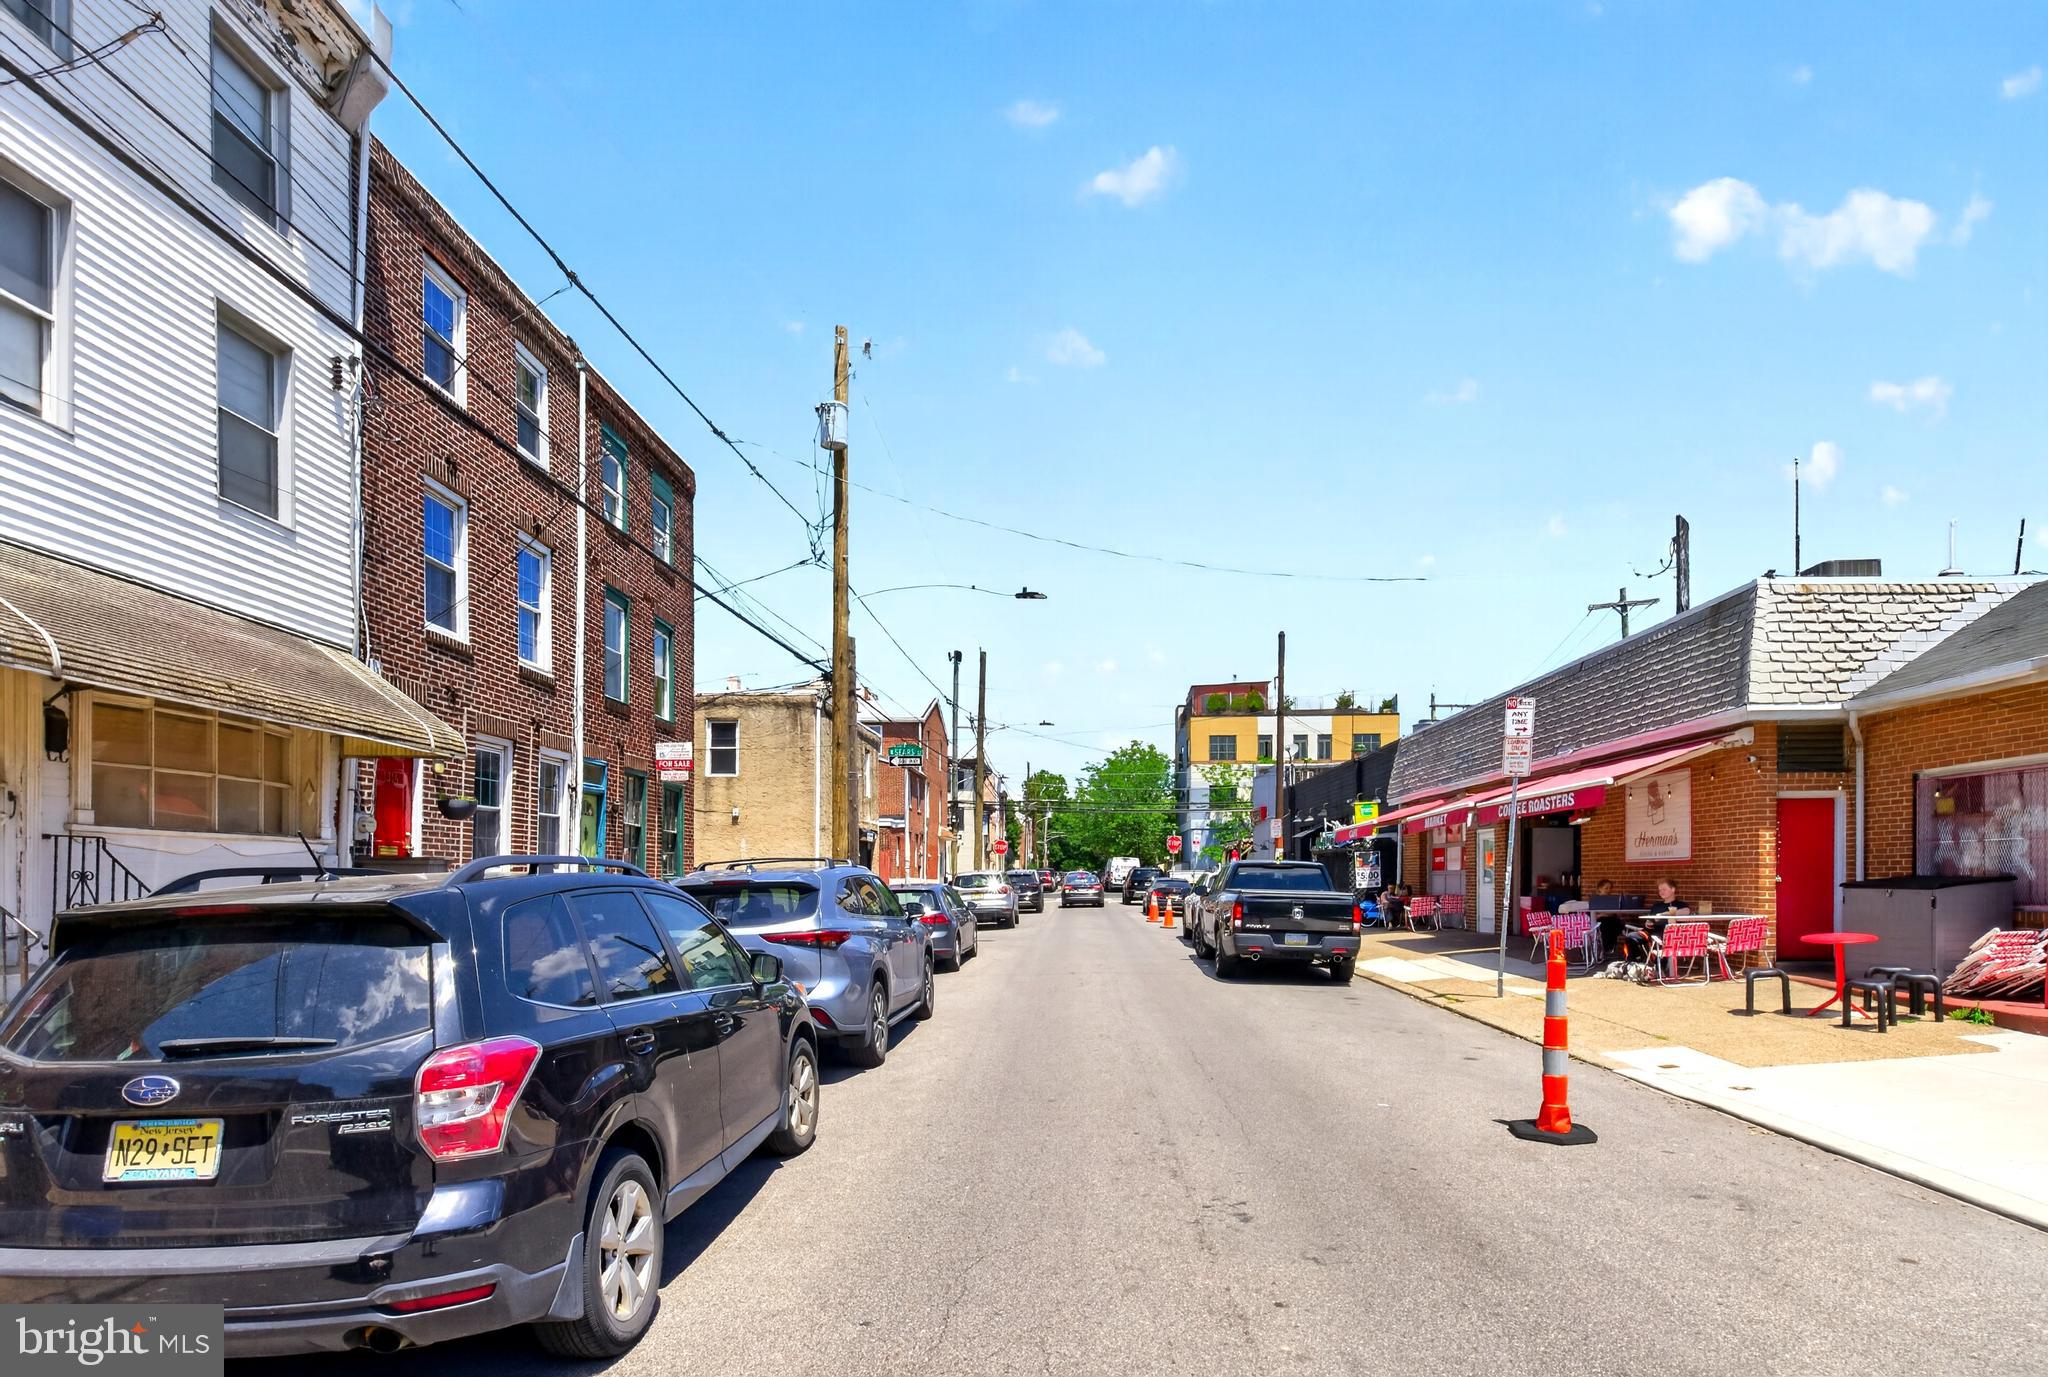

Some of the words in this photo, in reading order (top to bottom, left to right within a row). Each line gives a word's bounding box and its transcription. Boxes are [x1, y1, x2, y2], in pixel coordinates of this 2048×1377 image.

[895, 748, 916, 756] SEARS
[1528, 792, 1575, 813] ROASTERS
[1424, 813, 1447, 829] MARKET
[1634, 827, 1678, 848] Herman's
[291, 1108, 391, 1125] FORESTER
[140, 1127, 162, 1136] New
[163, 1126, 195, 1137] Jersey
